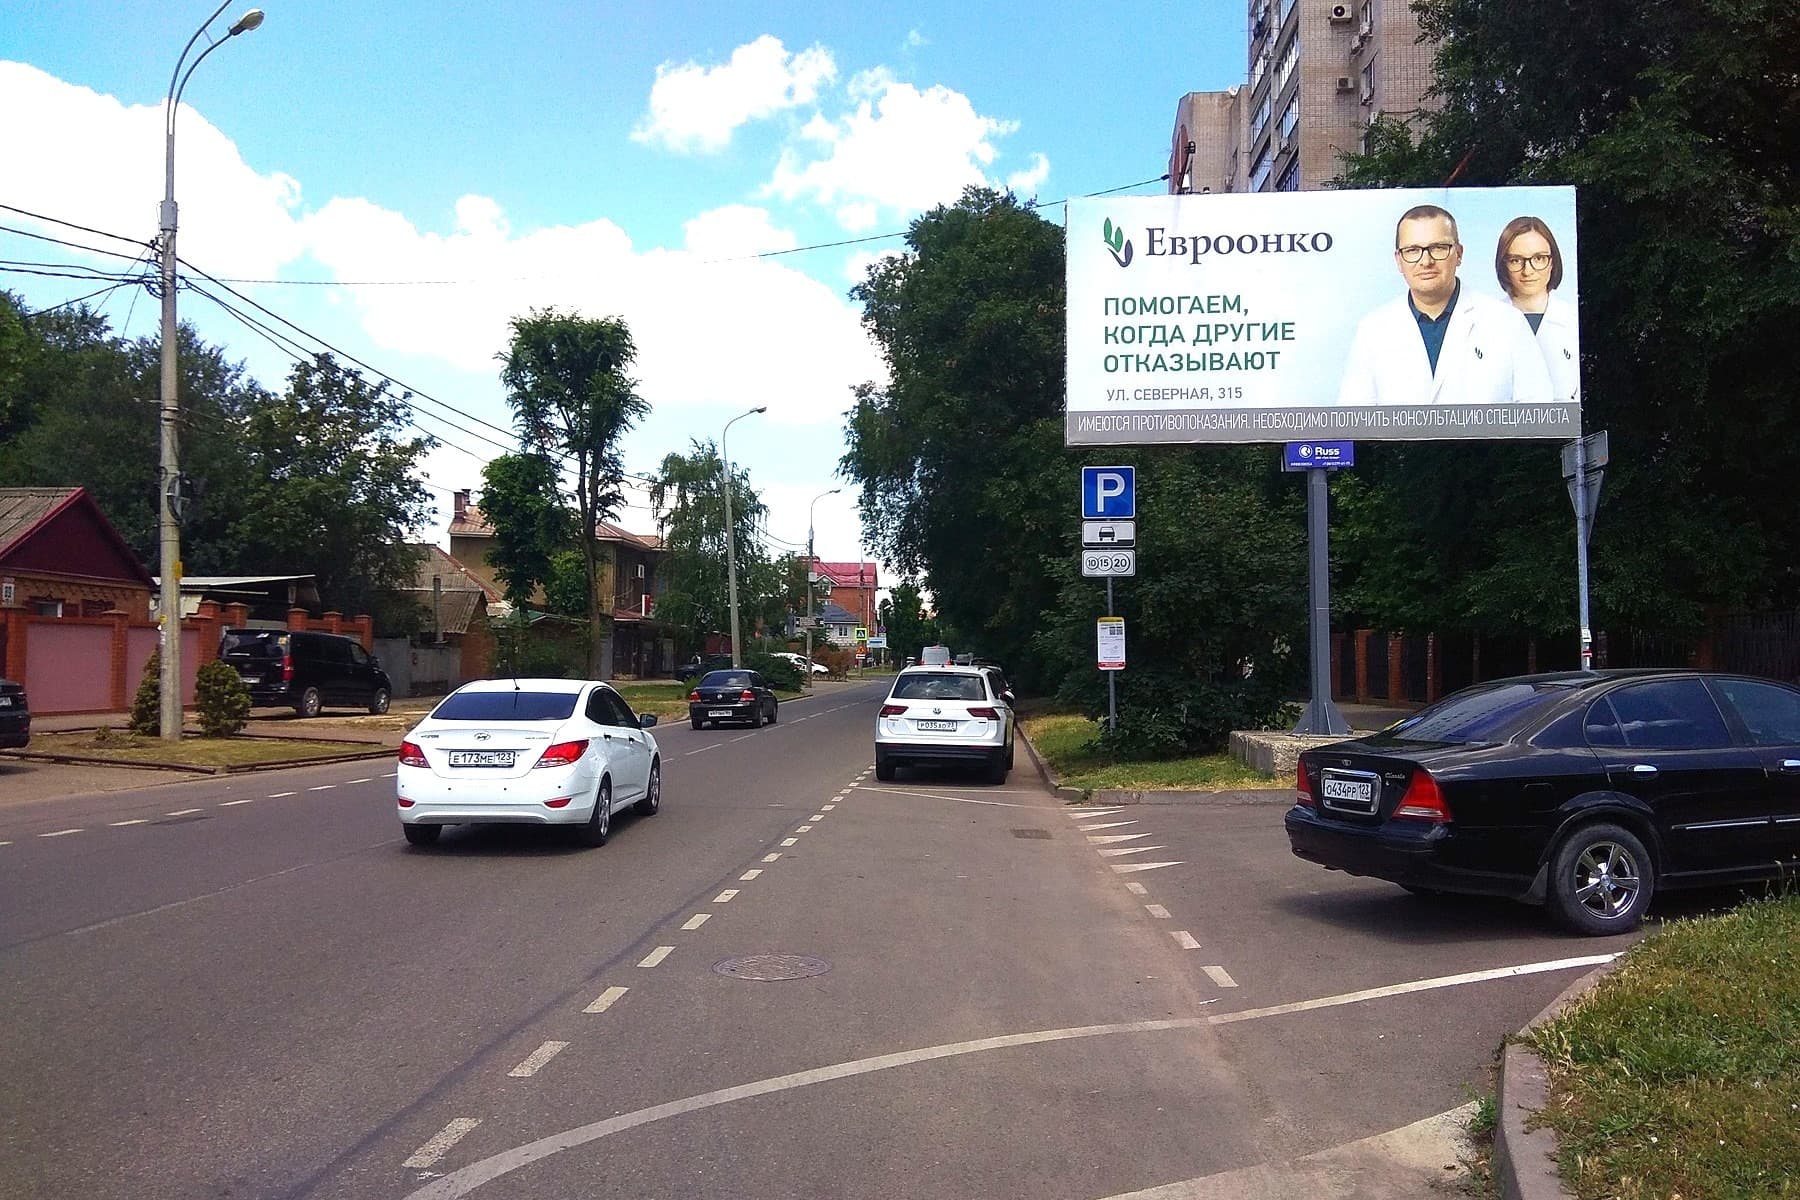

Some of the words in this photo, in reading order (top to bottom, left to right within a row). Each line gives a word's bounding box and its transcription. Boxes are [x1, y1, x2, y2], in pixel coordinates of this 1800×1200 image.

[1145, 227, 1333, 265] Евроонко
[1104, 294, 1249, 316] ПОМОГАЕМ,
[1104, 324, 1186, 347] КОГДА
[1192, 321, 1296, 346] ДРУГИЕ
[1103, 351, 1281, 373] ОТКАЗЫВАЮТ
[1106, 388, 1130, 401] УЛ.
[1134, 387, 1214, 401] СЕВЕРНАЯ,
[1218, 386, 1243, 399] 315
[1078, 415, 1130, 432] ИМЕЮТСЯ
[1132, 413, 1250, 431] ПРОТИВОПОКАЗАНИЯ.
[1253, 411, 1328, 431] НЕОБХОДИМО
[1330, 410, 1390, 427] ПОЛУЧИТЬ
[1392, 408, 1484, 428] КОНСУЛЬТАЦИЮ
[1486, 407, 1570, 427] СПЕЦИАЛИСТА
[1315, 446, 1340, 456] Russ
[1097, 473, 1125, 513] P
[1088, 559, 1097, 567] 10
[1100, 559, 1109, 568] 15
[1114, 558, 1127, 568] 20
